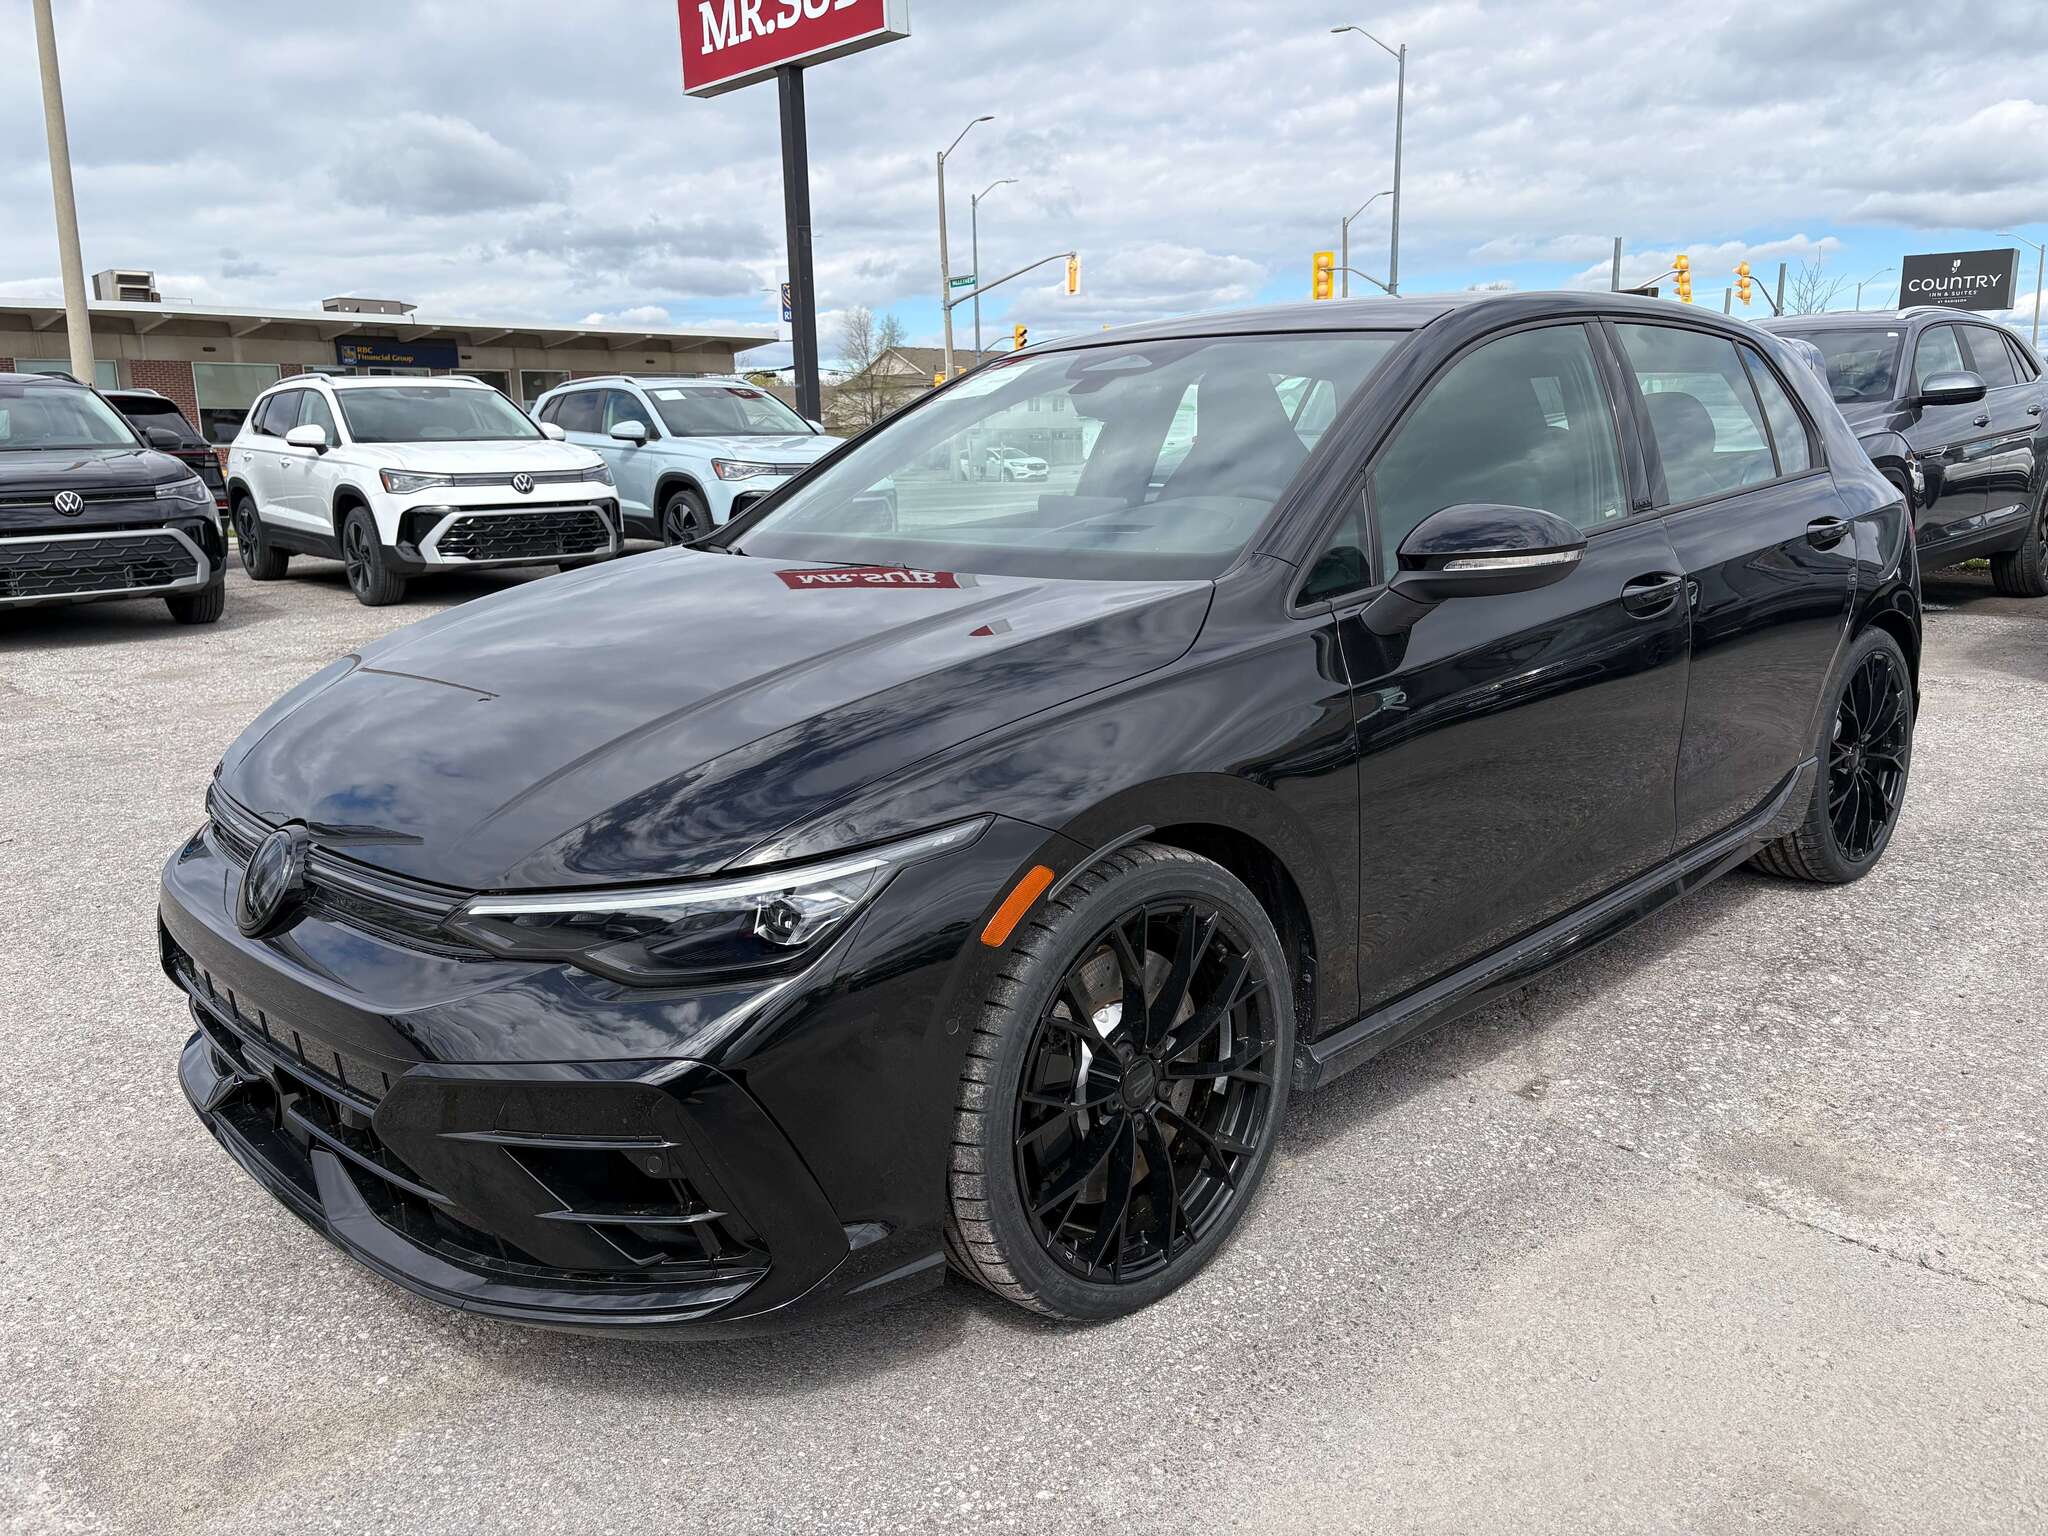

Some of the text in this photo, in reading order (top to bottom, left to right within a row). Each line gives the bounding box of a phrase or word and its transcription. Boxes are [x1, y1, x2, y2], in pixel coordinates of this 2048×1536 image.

[1908, 273, 2002, 291] COUNTRY
[357, 353, 391, 361] Financial
[391, 354, 414, 363] Group
